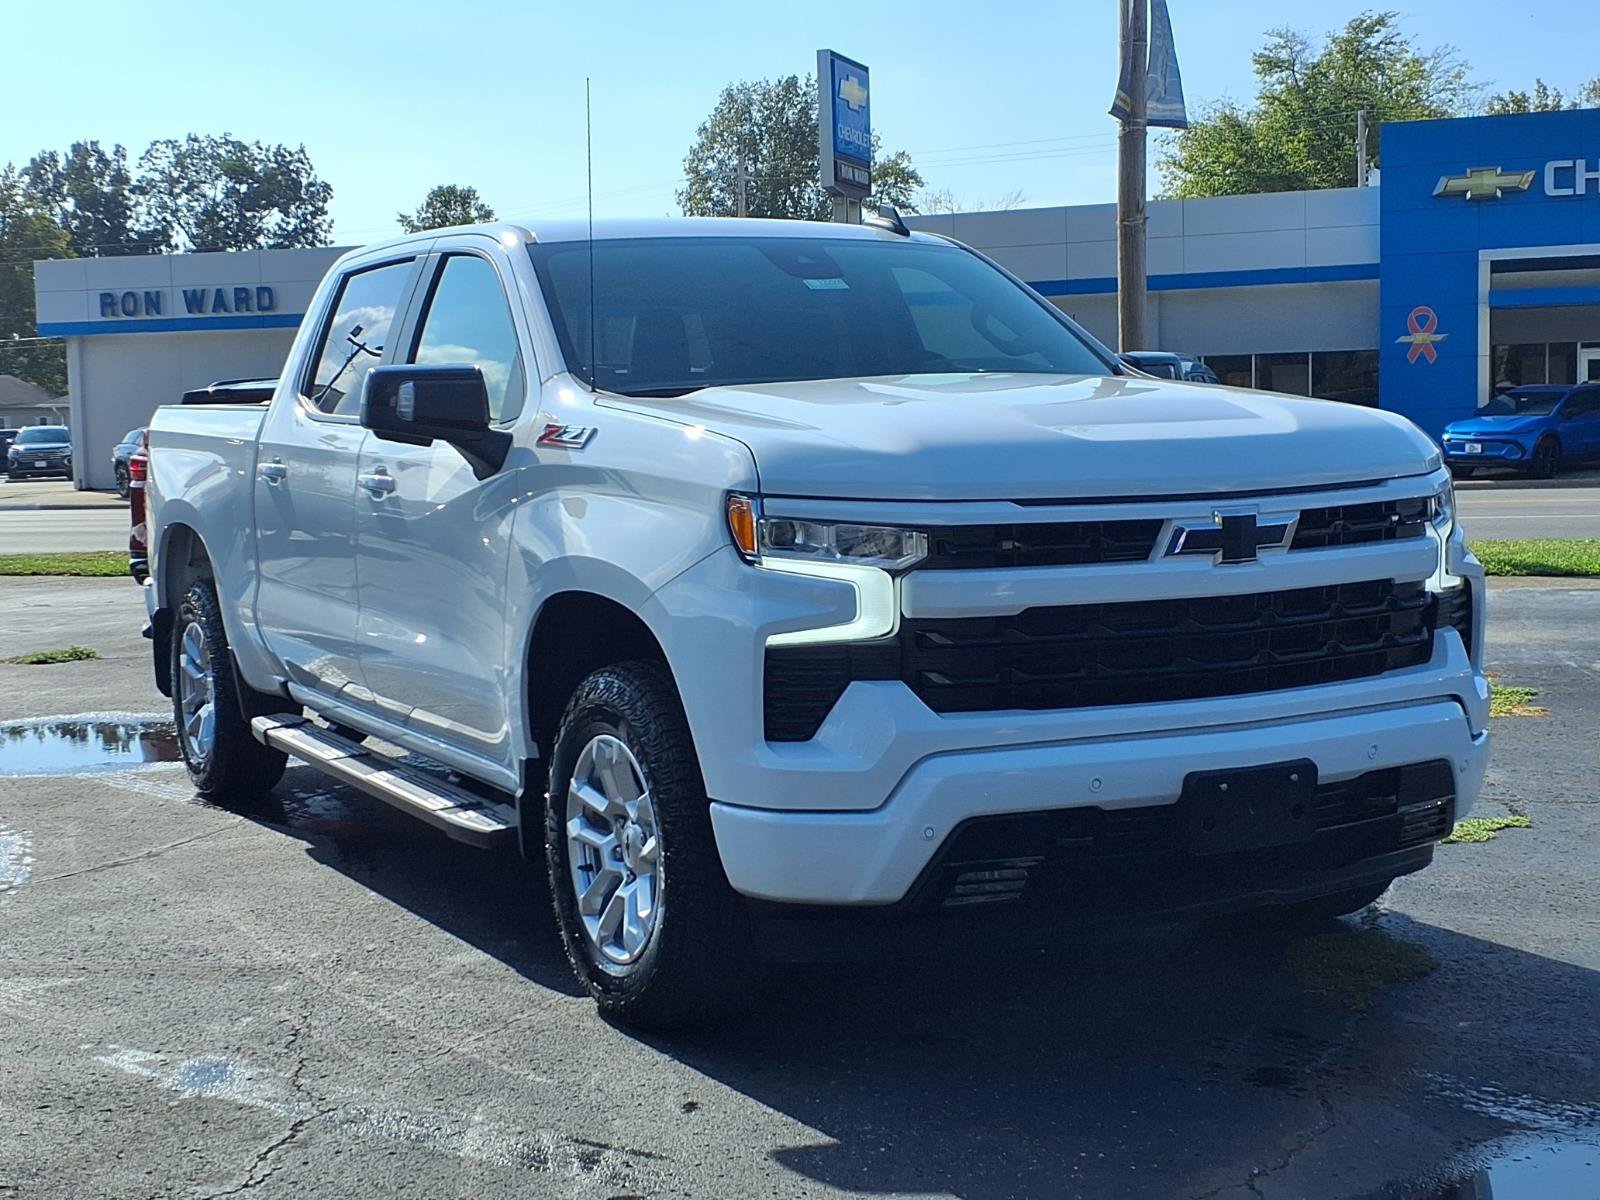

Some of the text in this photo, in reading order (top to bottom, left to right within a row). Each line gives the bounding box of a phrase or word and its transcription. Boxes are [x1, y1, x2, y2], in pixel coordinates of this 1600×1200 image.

[837, 123, 870, 148] CHEVROLET
[1544, 158, 1600, 196] CH
[99, 286, 275, 317] RON WARD
[536, 423, 598, 449] Z71
